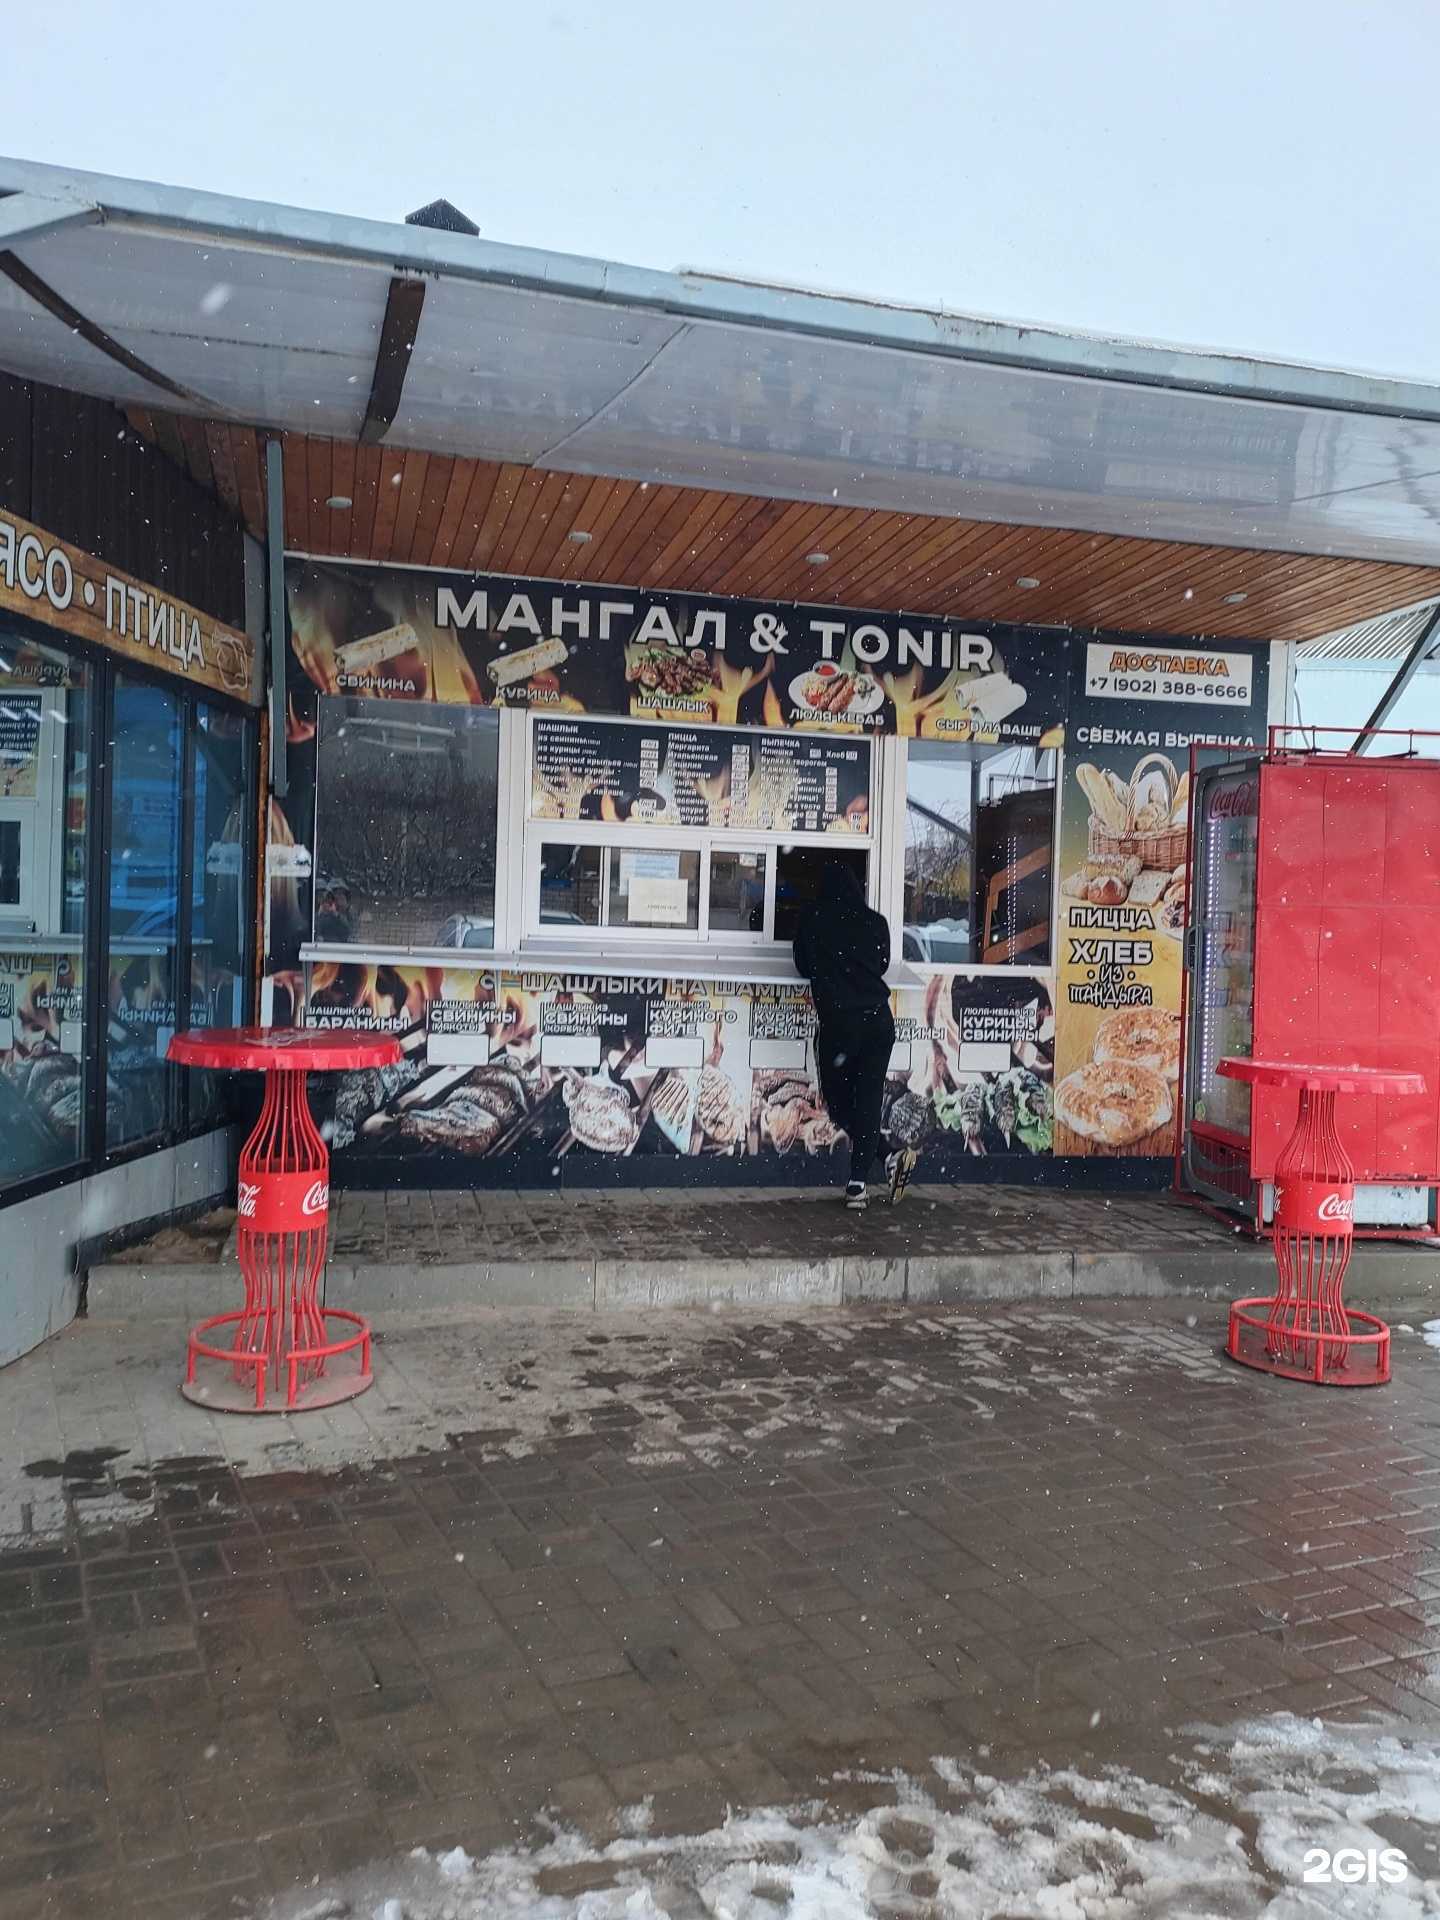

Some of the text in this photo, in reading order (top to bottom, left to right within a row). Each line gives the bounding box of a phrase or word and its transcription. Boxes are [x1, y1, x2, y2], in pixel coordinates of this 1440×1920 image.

[105, 574, 206, 671] ПТИЦА
[436, 586, 995, 672] МАНГАЛ & TONIR
[1109, 651, 1230, 677] ДОСТАВКА
[336, 674, 416, 692] СВИНИНА
[1090, 677, 1248, 699] +7 (902) 388-6666
[495, 686, 561, 703] КУРИЦА
[637, 696, 711, 713] ШАШЛЫК
[789, 709, 885, 726] ЛЮЛЯ-КЕБАБ
[538, 723, 579, 734] ШАШЛЫК
[936, 718, 967, 731] СЫР
[982, 721, 1042, 736] ЛАВАШЕ
[668, 733, 697, 743] ПИЦЦА
[762, 738, 800, 748] ВЫПЕЧКА
[1076, 727, 1160, 746] СВЕЖАЯ
[550, 746, 580, 755] курицы
[1069, 906, 1156, 931] ПИЦЦА
[1068, 938, 1153, 966] ХЛЕБ
[1099, 964, 1124, 984] ИЗ
[521, 972, 812, 998] ШАШЛЫКИ НА ШАМПУ
[1068, 983, 1152, 1009] ТАНДЫРА
[306, 1016, 408, 1031] БАРАНИНЫ
[431, 1009, 516, 1024] СВИНИНЫ
[545, 1012, 628, 1026] СВИНИНЫ
[649, 1009, 738, 1024] КУРИНОГО
[754, 1010, 819, 1024] КУРИНЫ
[963, 1029, 1039, 1042] СВИНИНЫ
